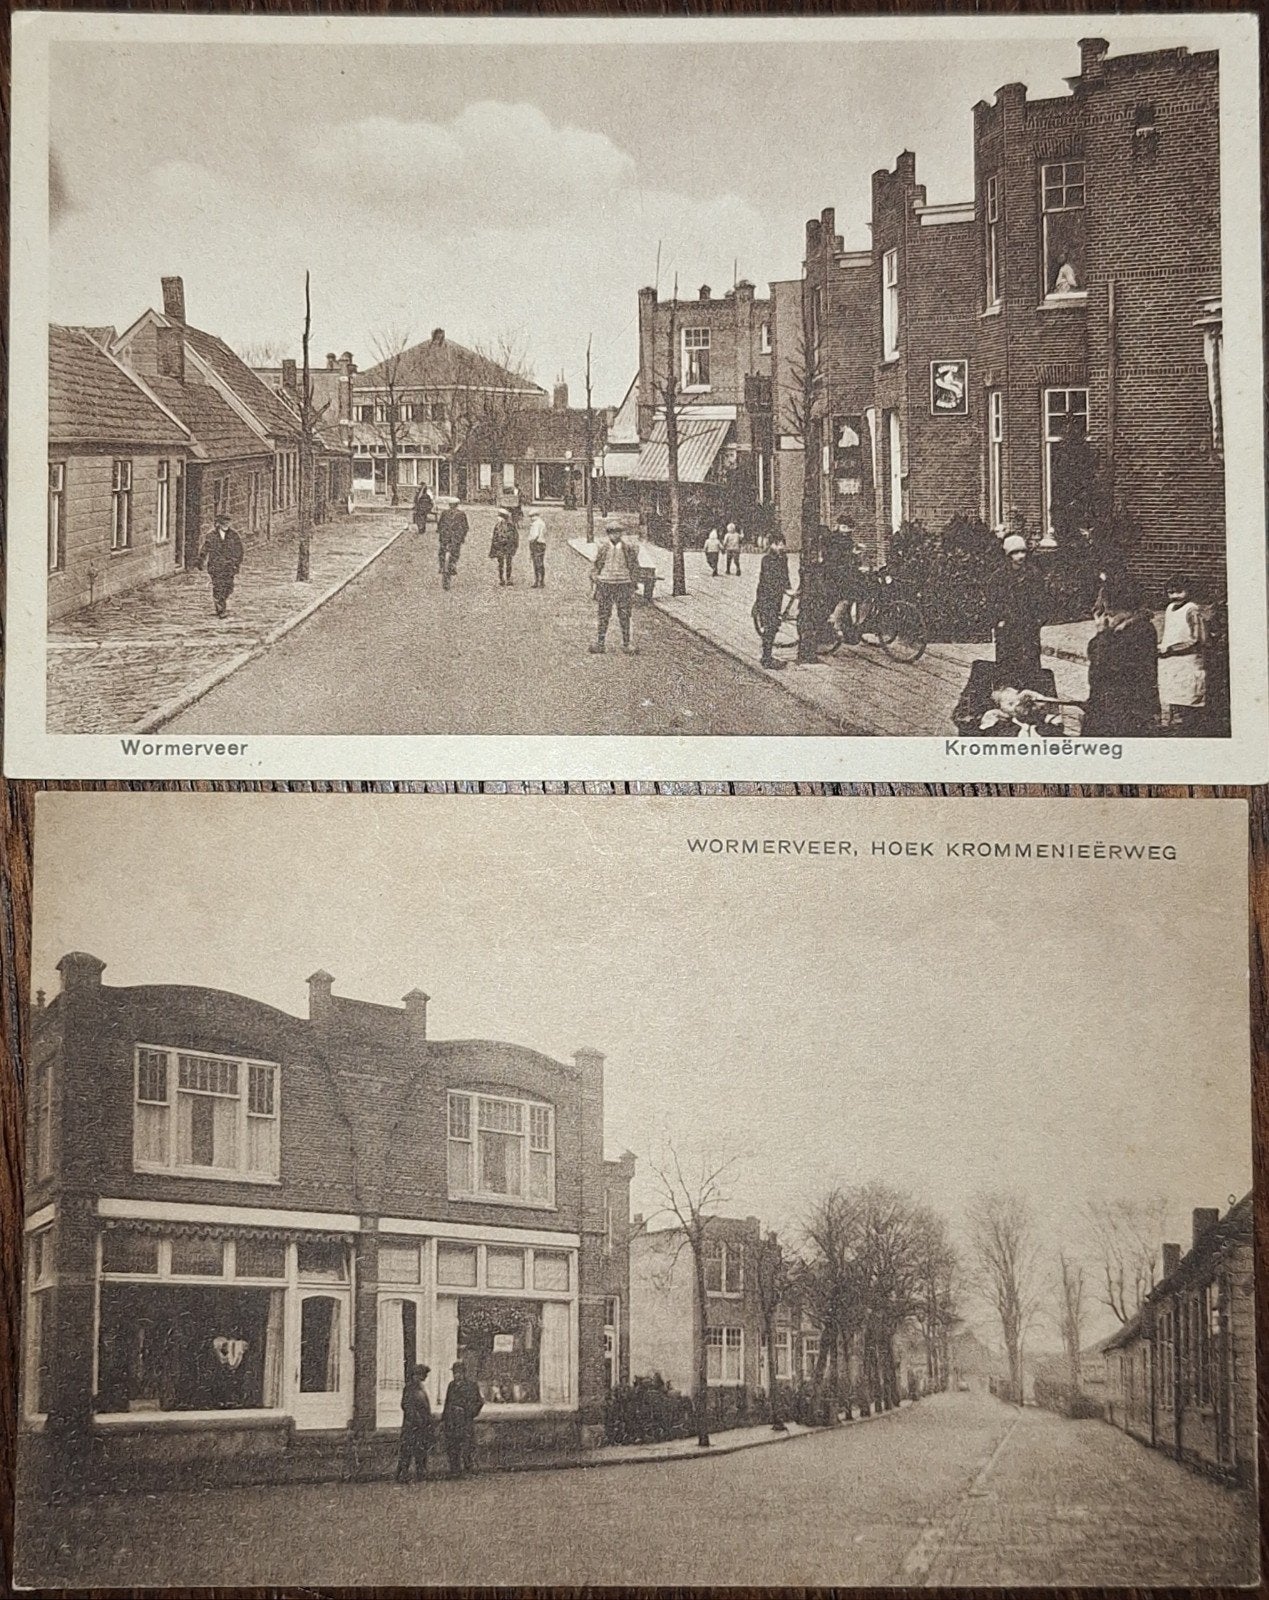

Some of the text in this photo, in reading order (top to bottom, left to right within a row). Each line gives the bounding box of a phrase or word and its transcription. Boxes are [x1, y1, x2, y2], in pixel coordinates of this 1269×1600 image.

[120, 739, 249, 756] Wormerveer
[945, 739, 1123, 760] Krommenieërweg
[686, 838, 1177, 861] WORMERVEER, HOEK KROMMENIEËRWEG
